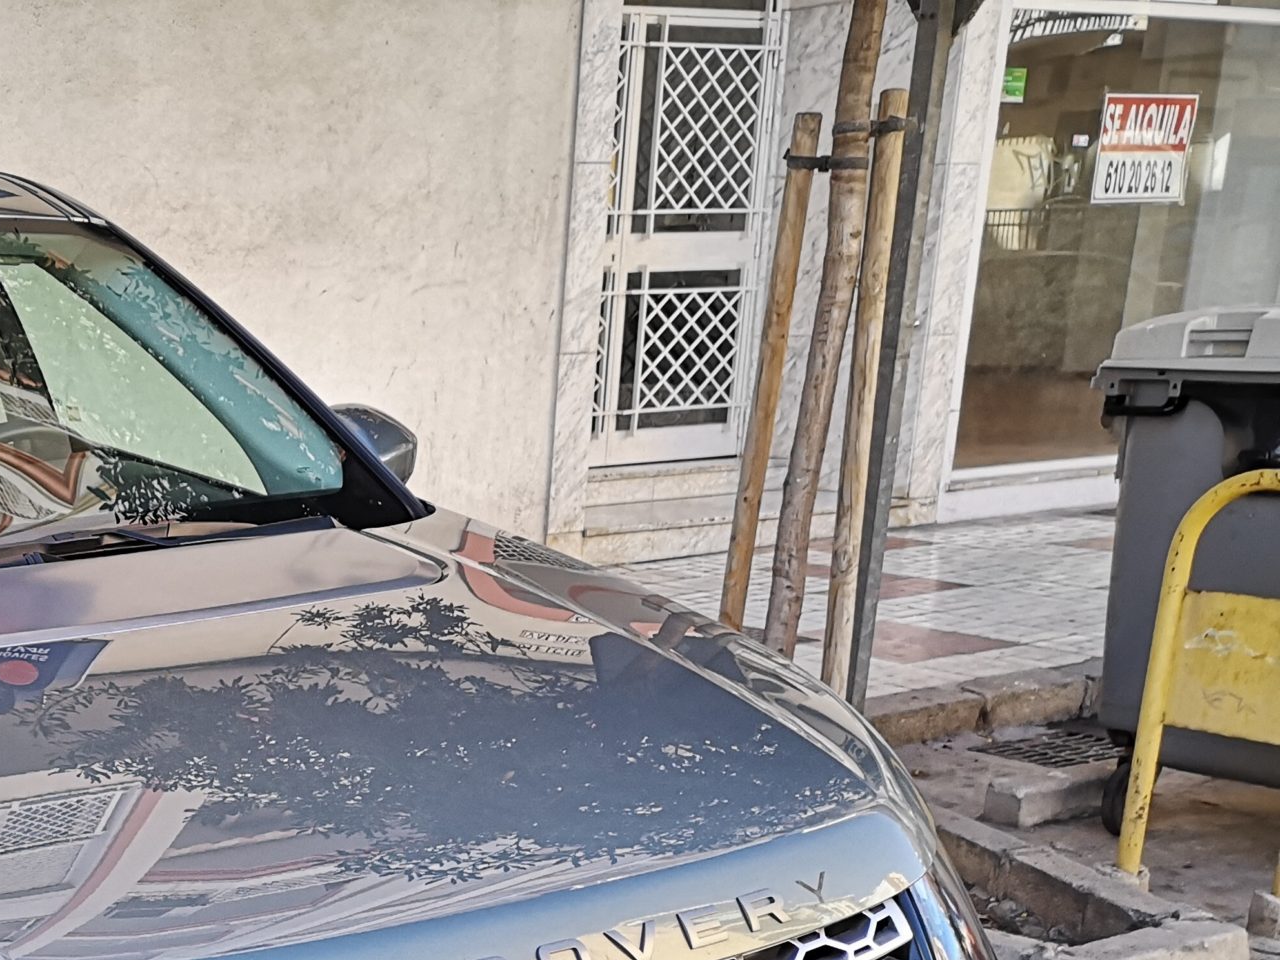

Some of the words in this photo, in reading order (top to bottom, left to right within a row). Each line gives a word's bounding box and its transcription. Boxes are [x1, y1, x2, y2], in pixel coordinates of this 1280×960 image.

[1102, 103, 1124, 145] SE
[1123, 103, 1192, 146] ALQUILA
[1104, 160, 1126, 194] 610
[1127, 160, 1141, 193] 20
[1143, 160, 1157, 193] 26
[1160, 160, 1173, 193] 12
